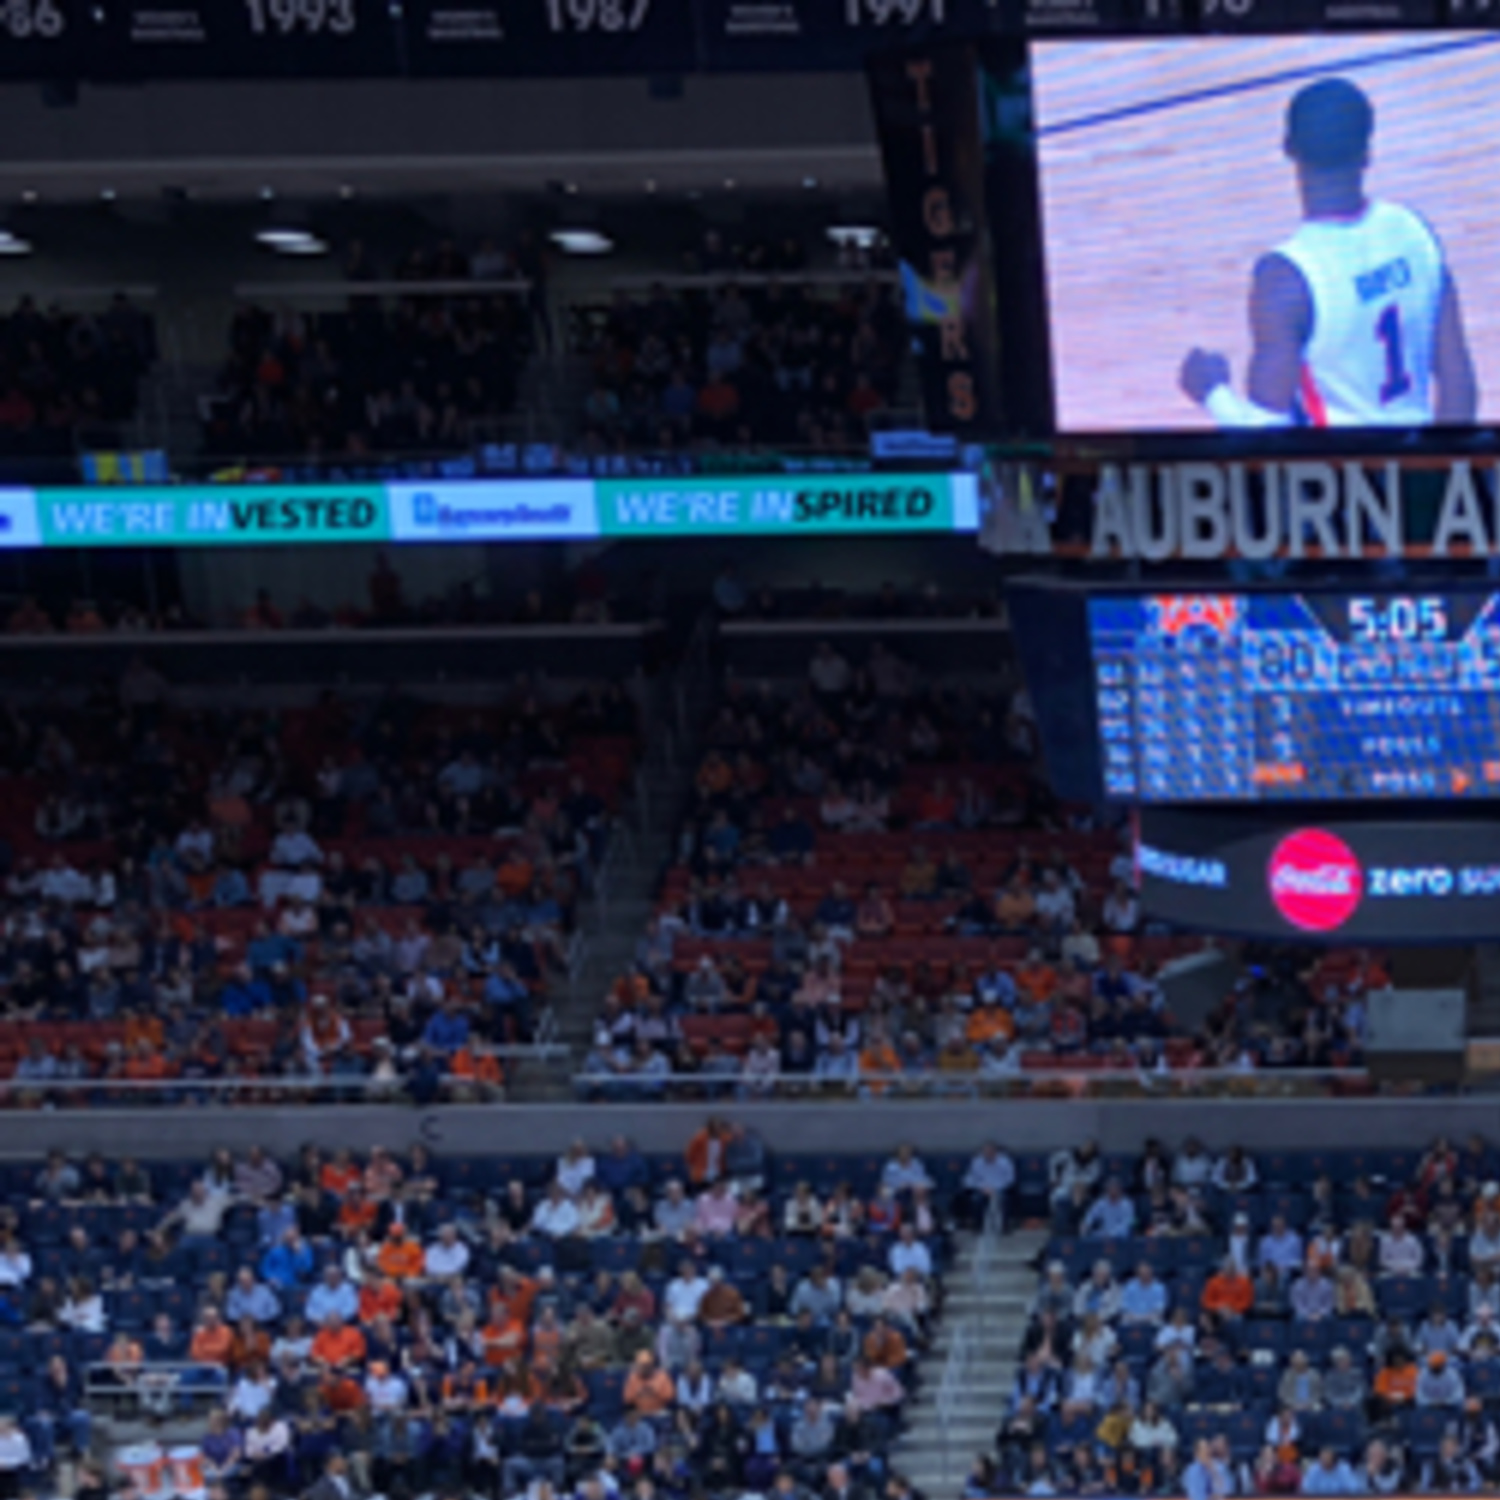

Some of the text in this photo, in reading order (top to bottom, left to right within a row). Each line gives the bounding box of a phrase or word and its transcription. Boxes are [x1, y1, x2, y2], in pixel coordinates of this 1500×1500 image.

[904, 58, 978, 423] TIGERS
[52, 500, 175, 533] WE'RE
[186, 496, 377, 532] INVESTED
[617, 486, 934, 524] WE'RE INSPIRED
[1090, 460, 1402, 560] AUBURN
[1348, 597, 1447, 639] 5:05
[1368, 867, 1453, 895] zero
